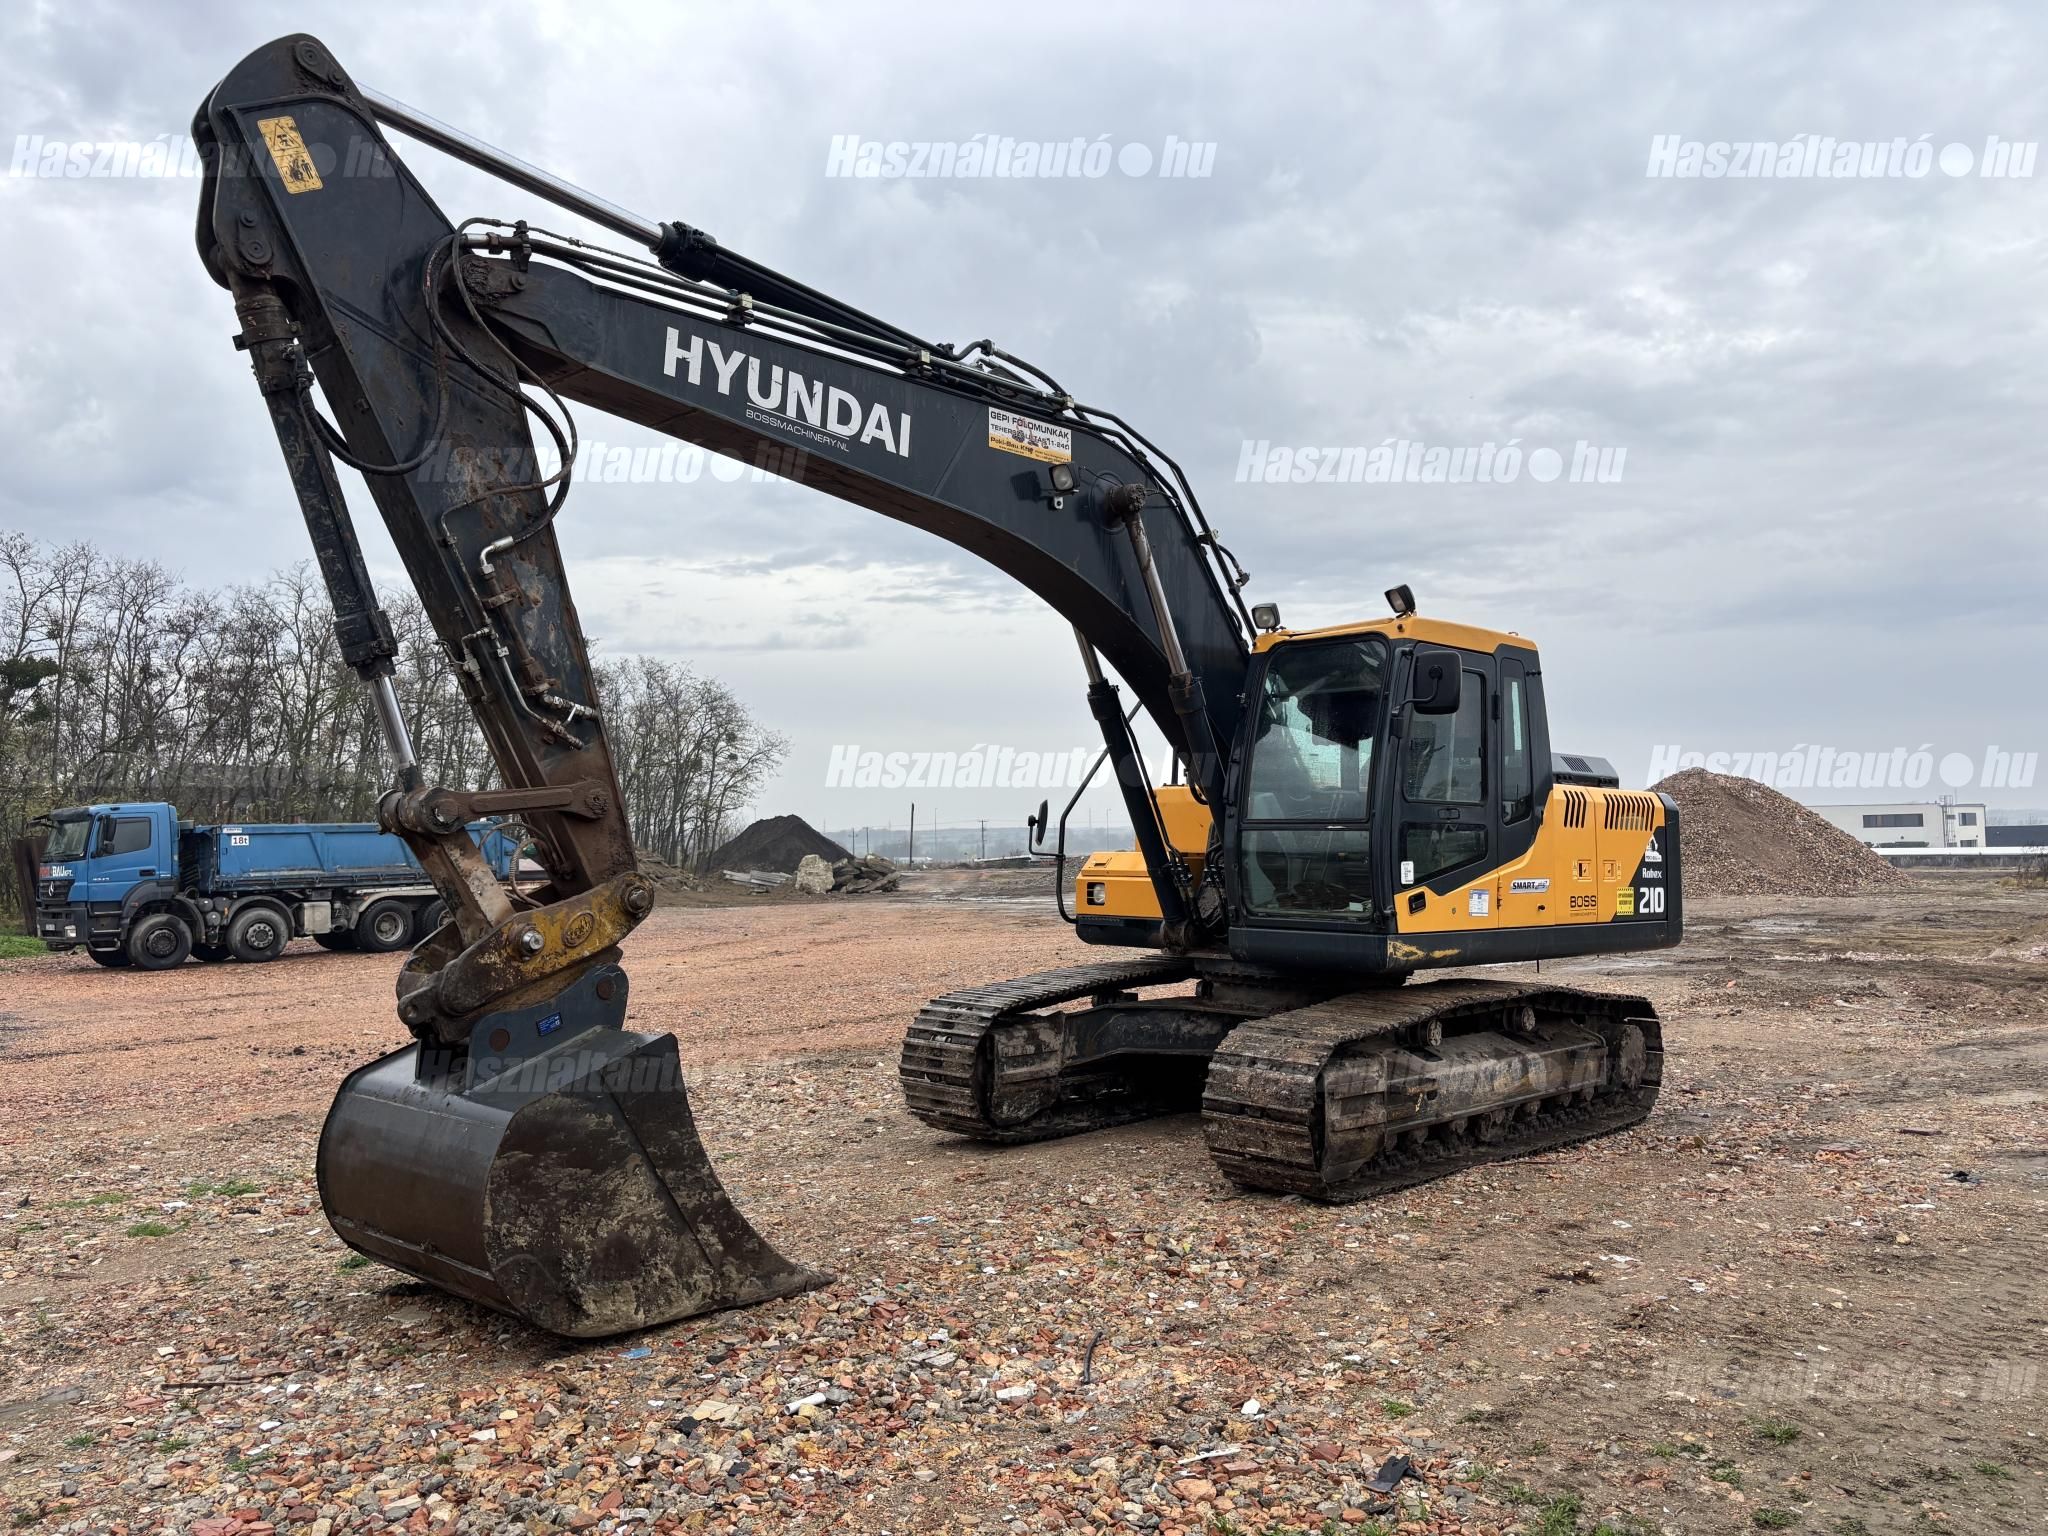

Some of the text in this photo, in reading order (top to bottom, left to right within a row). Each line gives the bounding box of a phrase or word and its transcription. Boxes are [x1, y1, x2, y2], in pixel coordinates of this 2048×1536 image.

[663, 326, 911, 458] HYUNDAI
[746, 408, 850, 452] BOSSMACHINERY.NL
[233, 836, 248, 845] 18t
[1642, 867, 1662, 879] Robex
[1512, 881, 1535, 890] SMART
[1570, 895, 1597, 908] BOSS
[1640, 887, 1665, 914] 210
